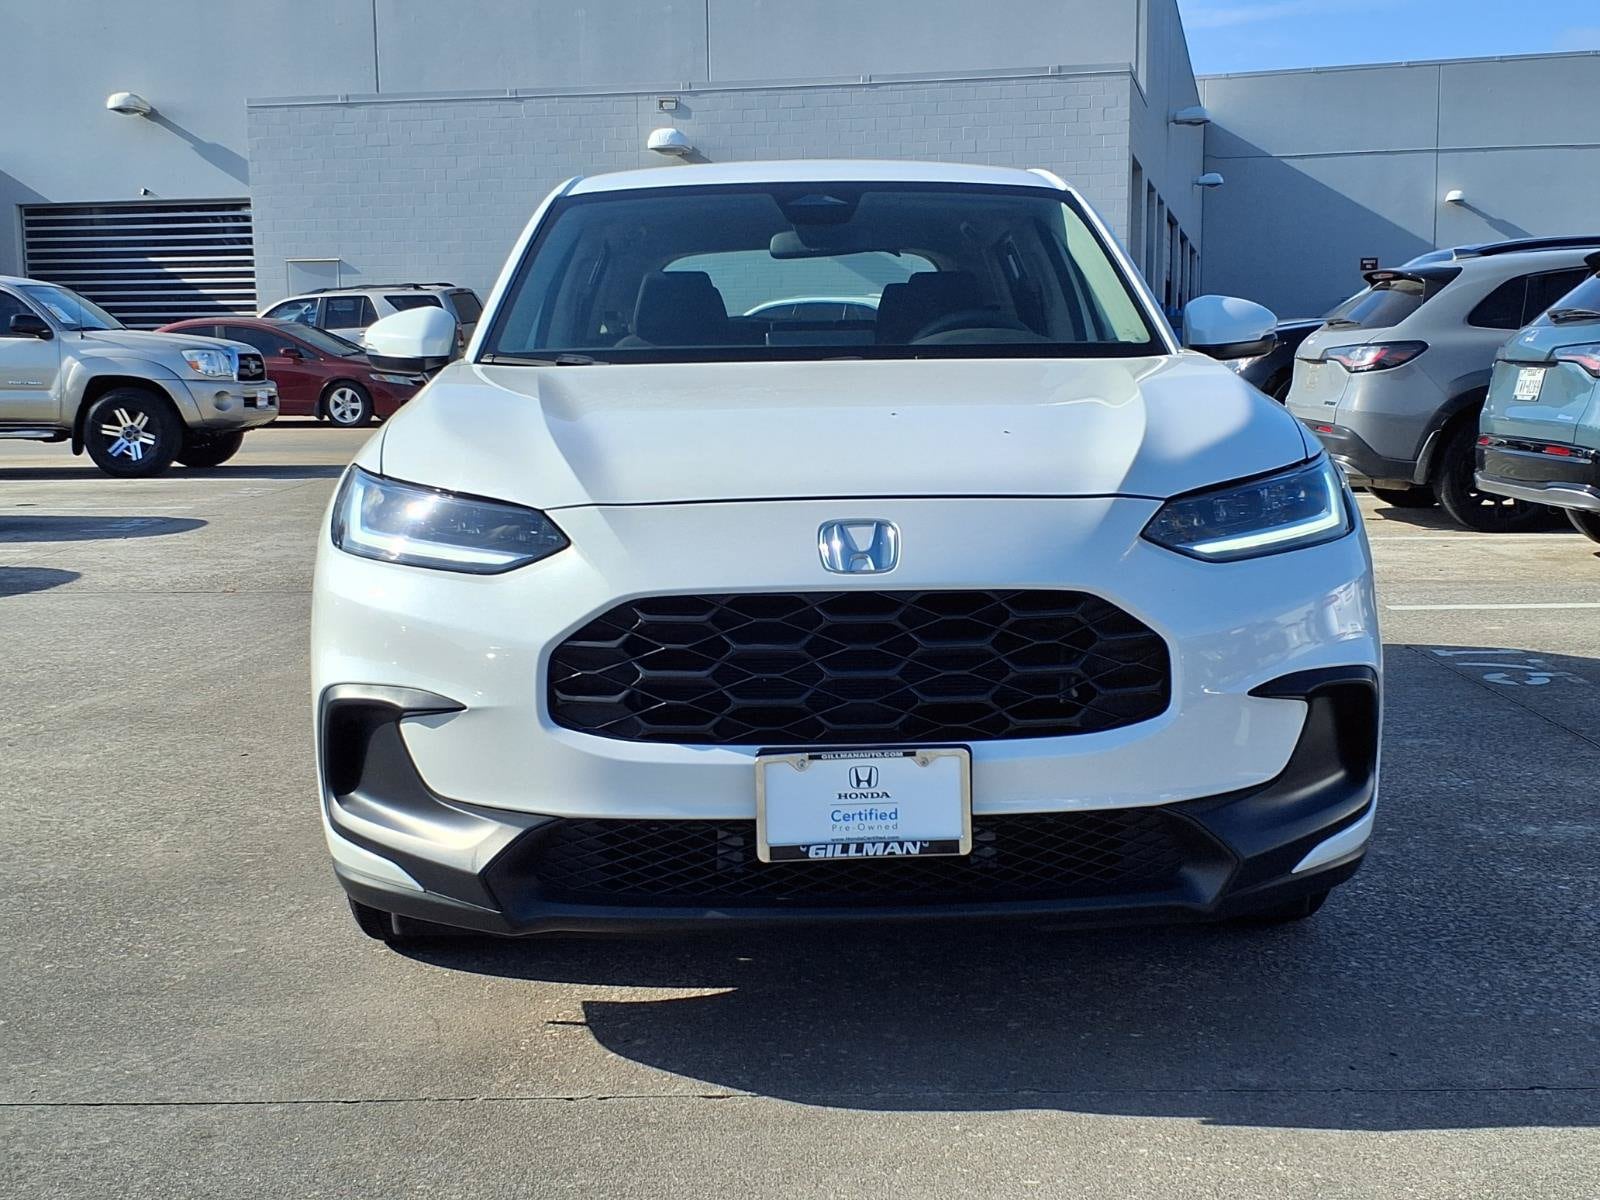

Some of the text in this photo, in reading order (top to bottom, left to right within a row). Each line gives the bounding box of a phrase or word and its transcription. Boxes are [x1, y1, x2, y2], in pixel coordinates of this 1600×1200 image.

[821, 751, 903, 760] GILLMANAUTO.COM
[837, 792, 890, 800] HONDA
[831, 808, 898, 823] Certified
[832, 823, 898, 832] Pre-Owned
[808, 841, 921, 859] GILLMAN
